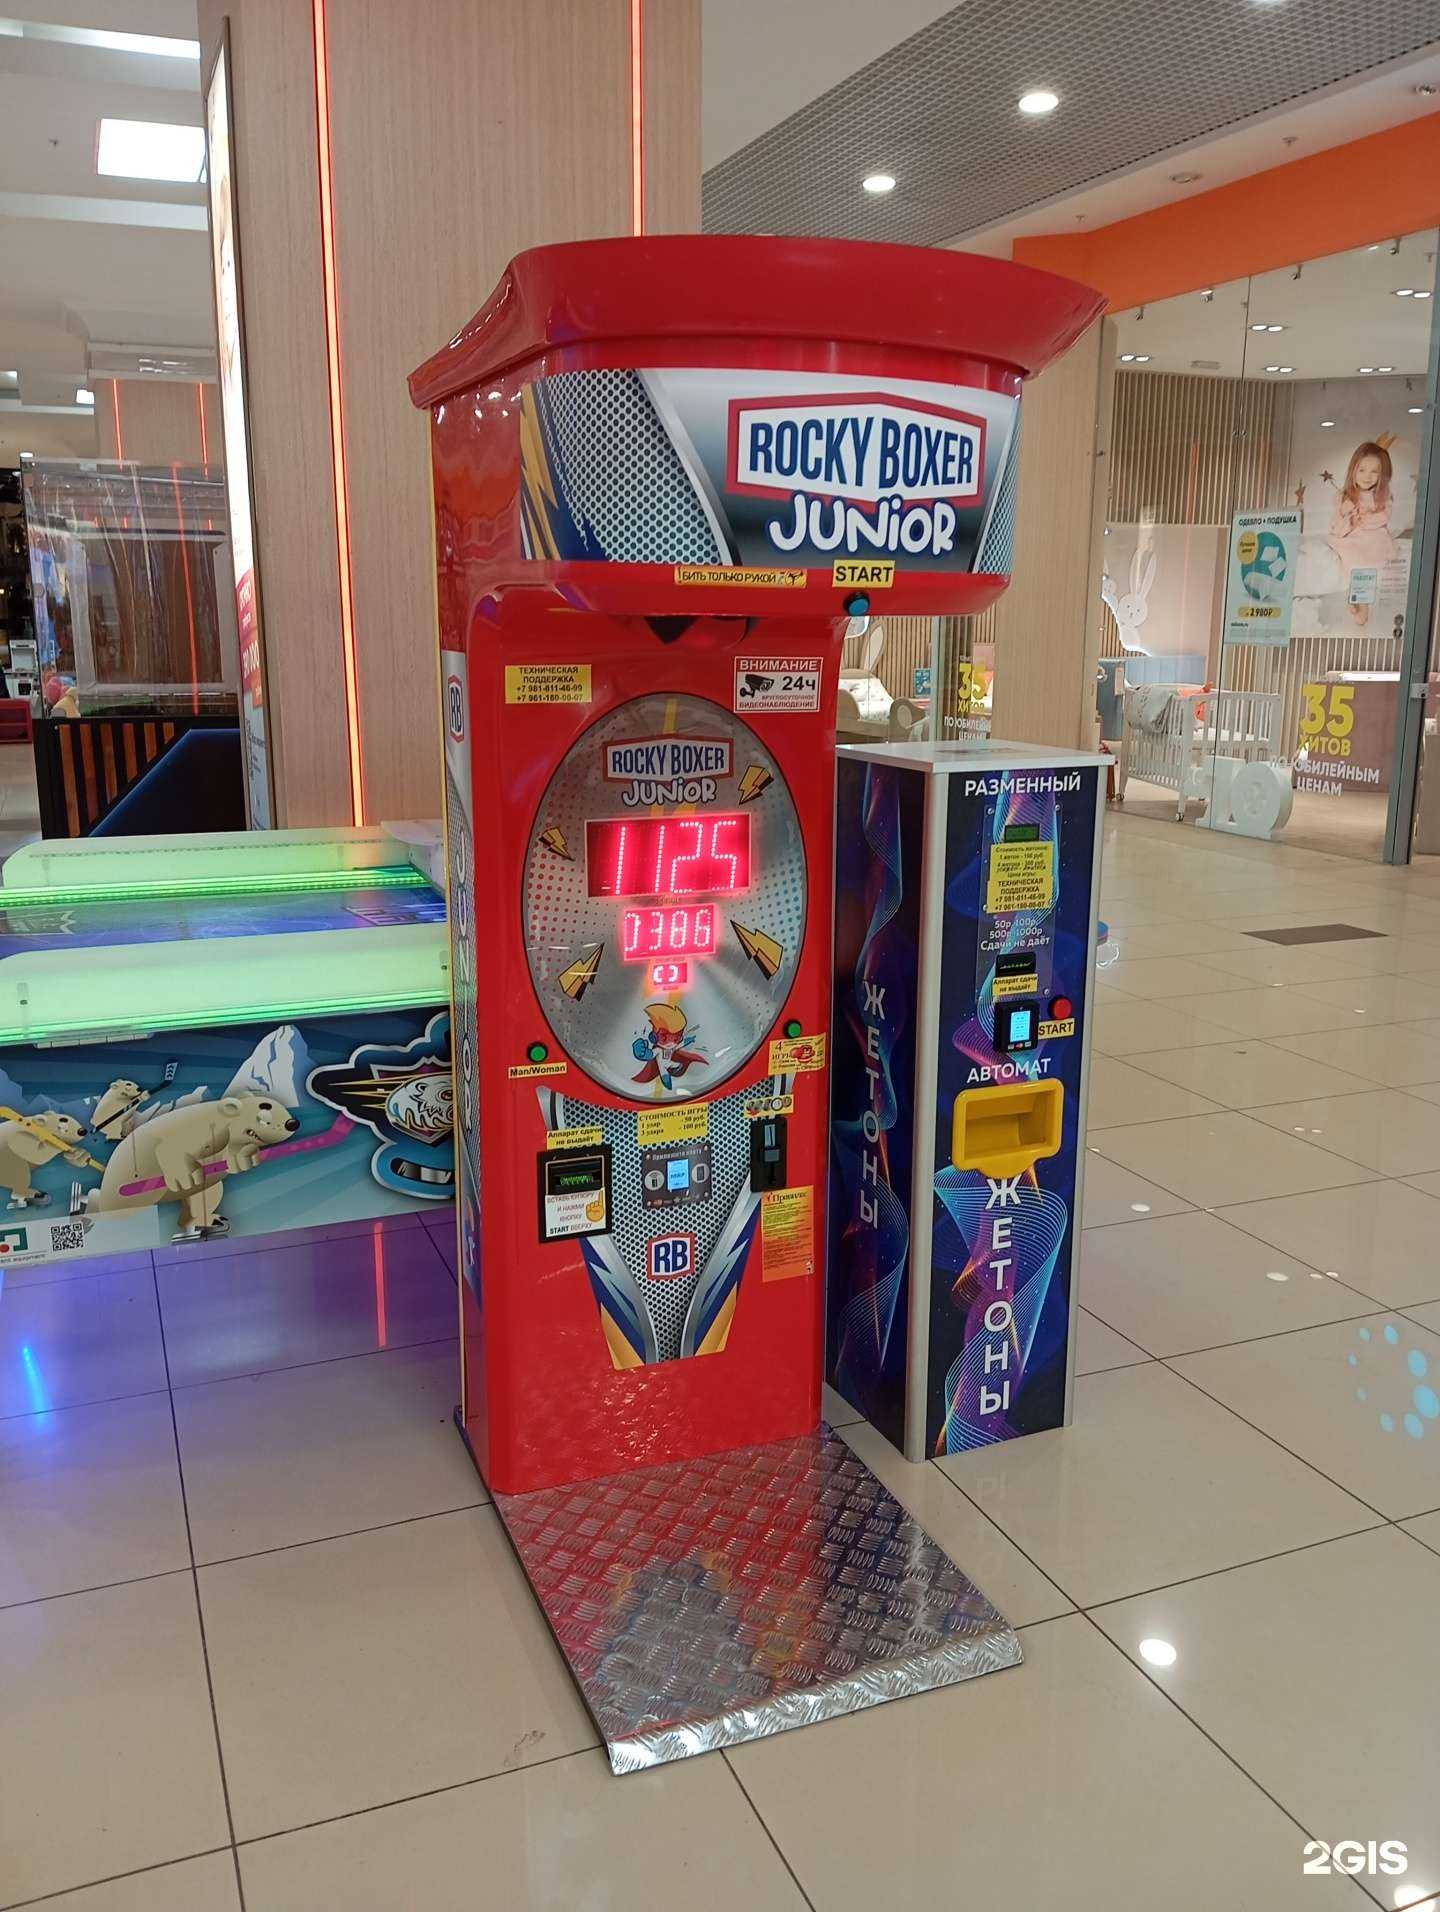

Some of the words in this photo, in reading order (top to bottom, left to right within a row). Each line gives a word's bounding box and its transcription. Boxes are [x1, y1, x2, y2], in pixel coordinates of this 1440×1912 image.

[750, 416, 874, 487] ROCKY
[878, 417, 974, 489] BOXER
[707, 571, 744, 582] ТОЛЬКО
[744, 572, 777, 584] РУКОЙ
[835, 566, 893, 582] START
[519, 666, 579, 675] ТЕХНИЧЕСКАЯ
[740, 660, 818, 671] ВНИМАНИЕ
[523, 675, 575, 684] ПОДДЕРЖКА
[958, 663, 989, 700] 35
[1300, 683, 1355, 738] 35
[1299, 734, 1352, 756] ХИТОВ
[612, 744, 667, 776] ROCKY
[671, 744, 724, 776] BOXER
[964, 771, 1081, 797] РАЗМЕННЫЙ
[1297, 776, 1342, 796] ЦЕНАМ
[998, 878, 1044, 887] ТЕХНИЧЕСКАЯ
[1000, 886, 1040, 895] ПОДДЕРЖКА
[980, 940, 1012, 951] Сдачи
[1014, 939, 1026, 947] не
[1027, 935, 1050, 947] даёт
[1038, 1021, 1074, 1036] START
[509, 1065, 566, 1077] Man/Woman
[966, 1057, 1052, 1084] АВТОМАТ
[639, 1110, 686, 1122] СТОИМОСТЬ
[686, 1105, 708, 1115] ИГРЫ
[860, 981, 886, 1230] ЖЕТОНЫ
[548, 1129, 579, 1139] Аппарат
[549, 1225, 570, 1236] START
[654, 1239, 688, 1273] RB
[979, 1177, 1022, 1415] ЖЕТОНЫ
